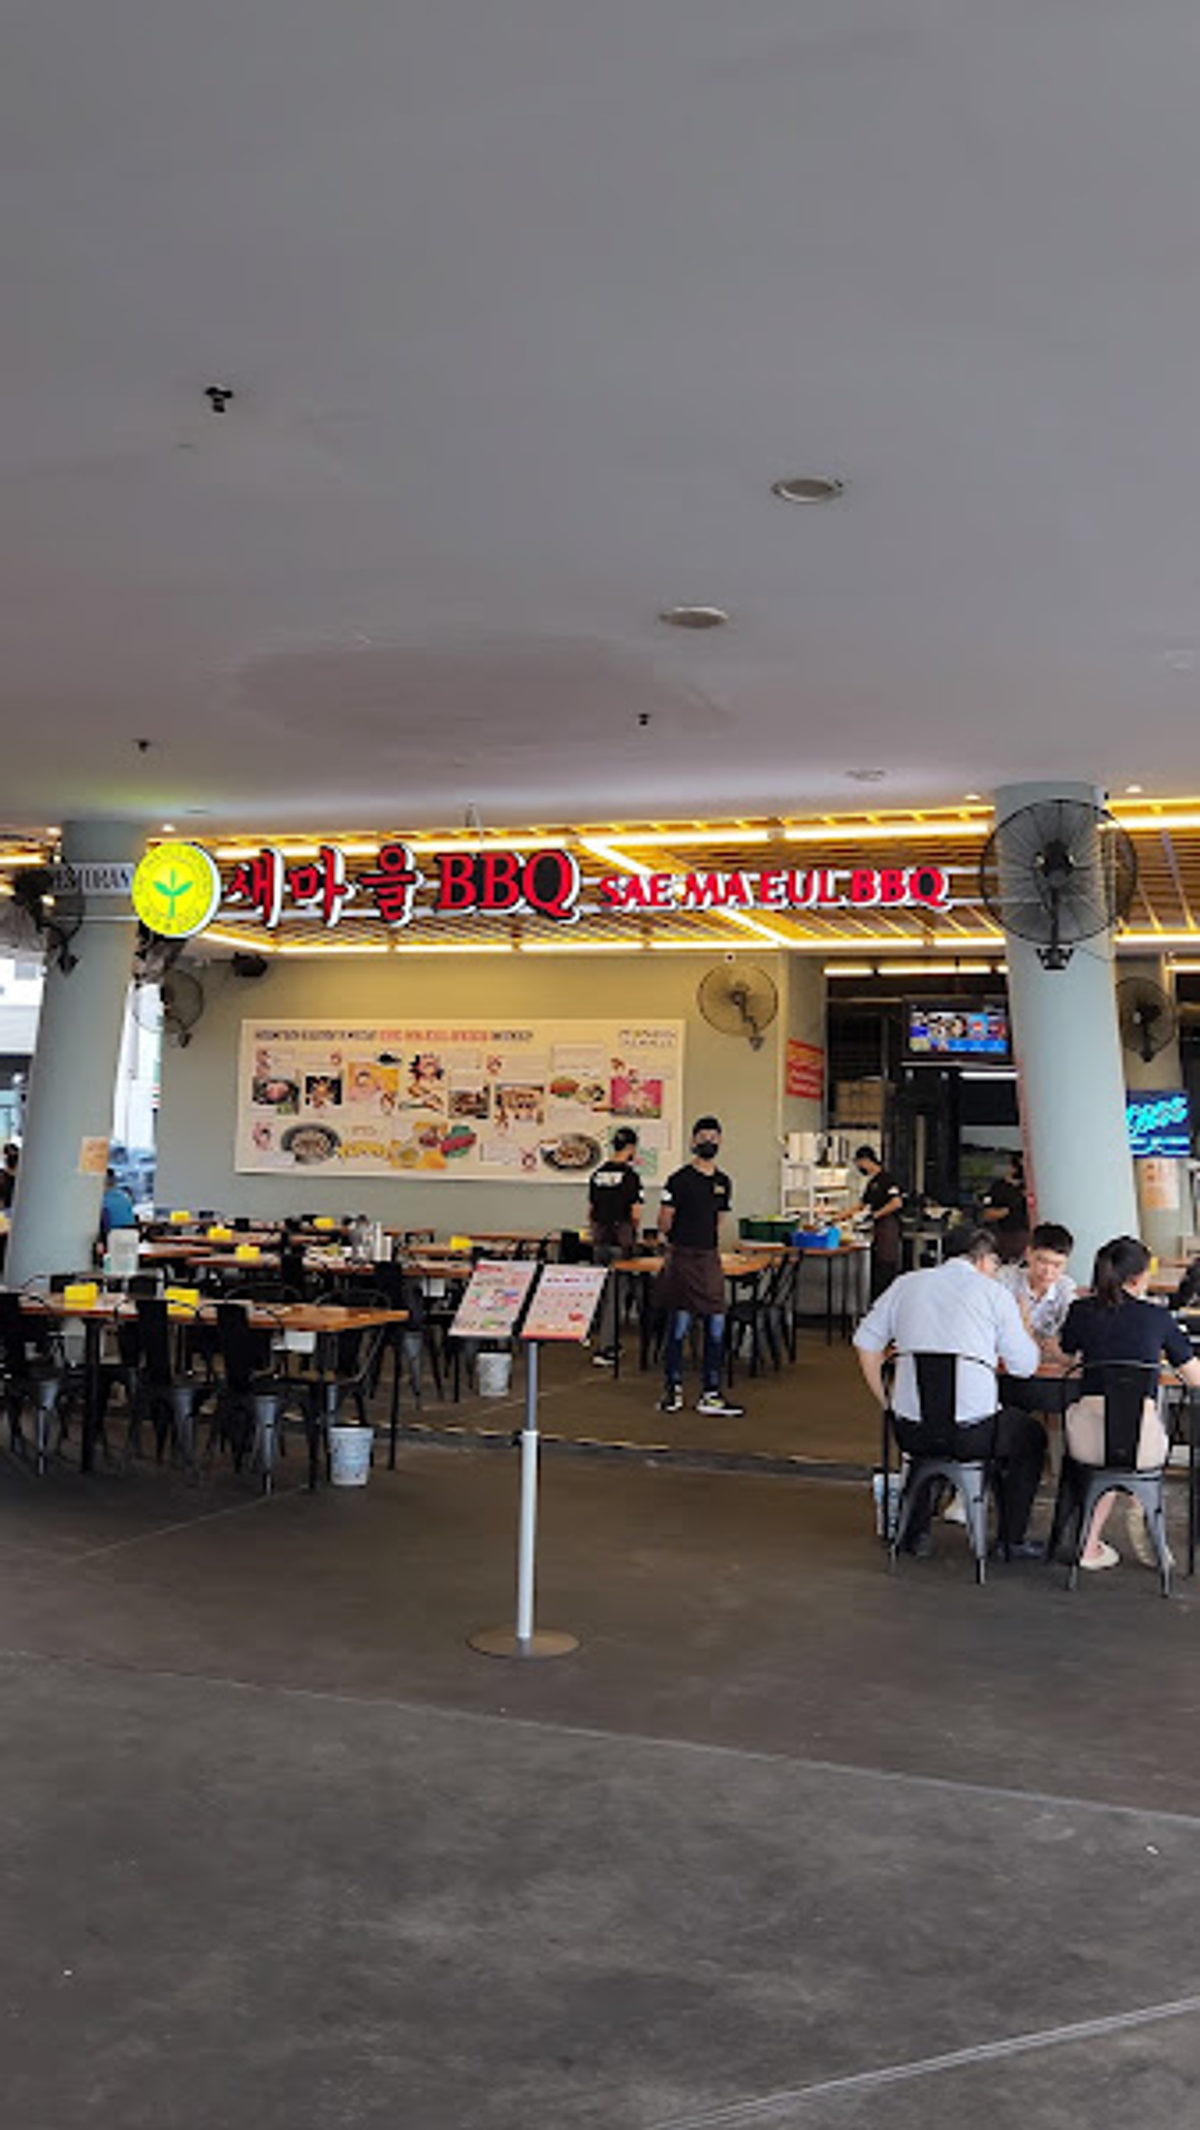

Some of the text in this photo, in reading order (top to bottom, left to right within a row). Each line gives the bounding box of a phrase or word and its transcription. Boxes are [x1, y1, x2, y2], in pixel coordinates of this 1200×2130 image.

[226, 845, 419, 924] 새마을
[434, 849, 575, 918] BBQ
[600, 867, 948, 908] SAE MA EUL BBQ
